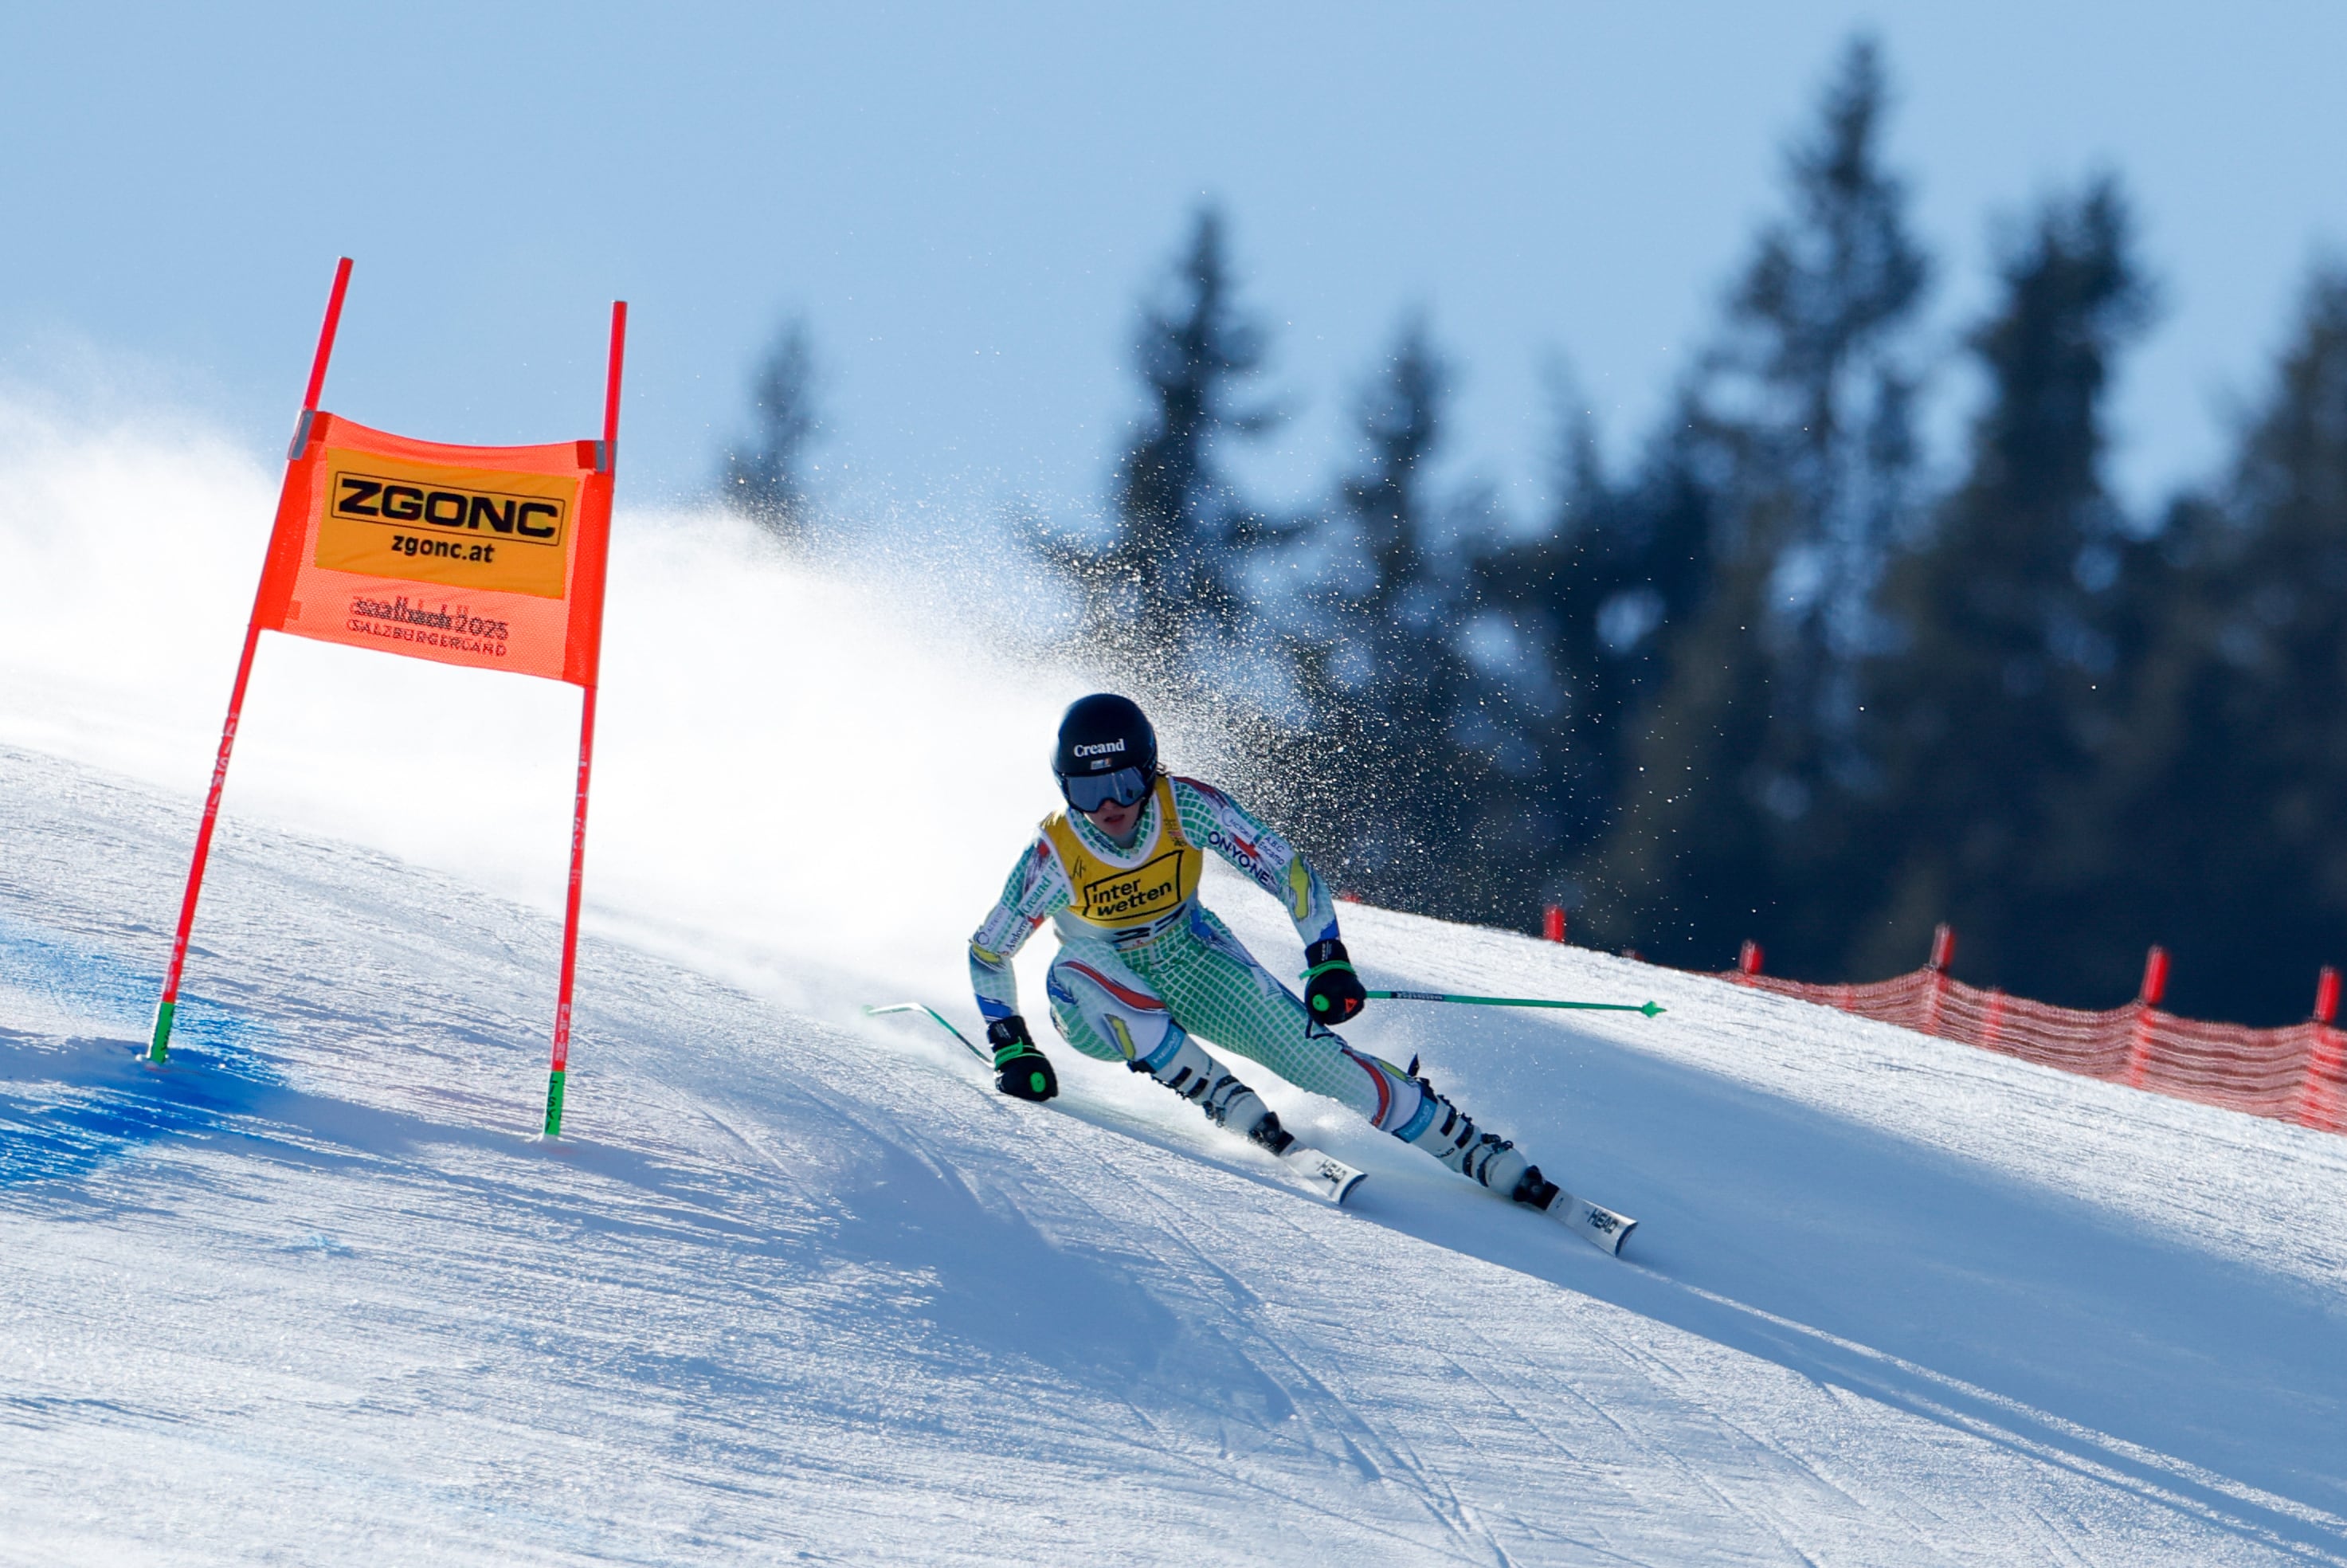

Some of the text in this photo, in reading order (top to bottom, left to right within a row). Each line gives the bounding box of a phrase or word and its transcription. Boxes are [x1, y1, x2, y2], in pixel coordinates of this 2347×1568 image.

[339, 478, 558, 538] ZGONC
[391, 535, 496, 563] zgonc.at
[1073, 738, 1126, 758] Creand
[1093, 879, 1141, 904] inter
[1097, 881, 1172, 916] wetten
[1586, 1208, 1620, 1235] HEAD
